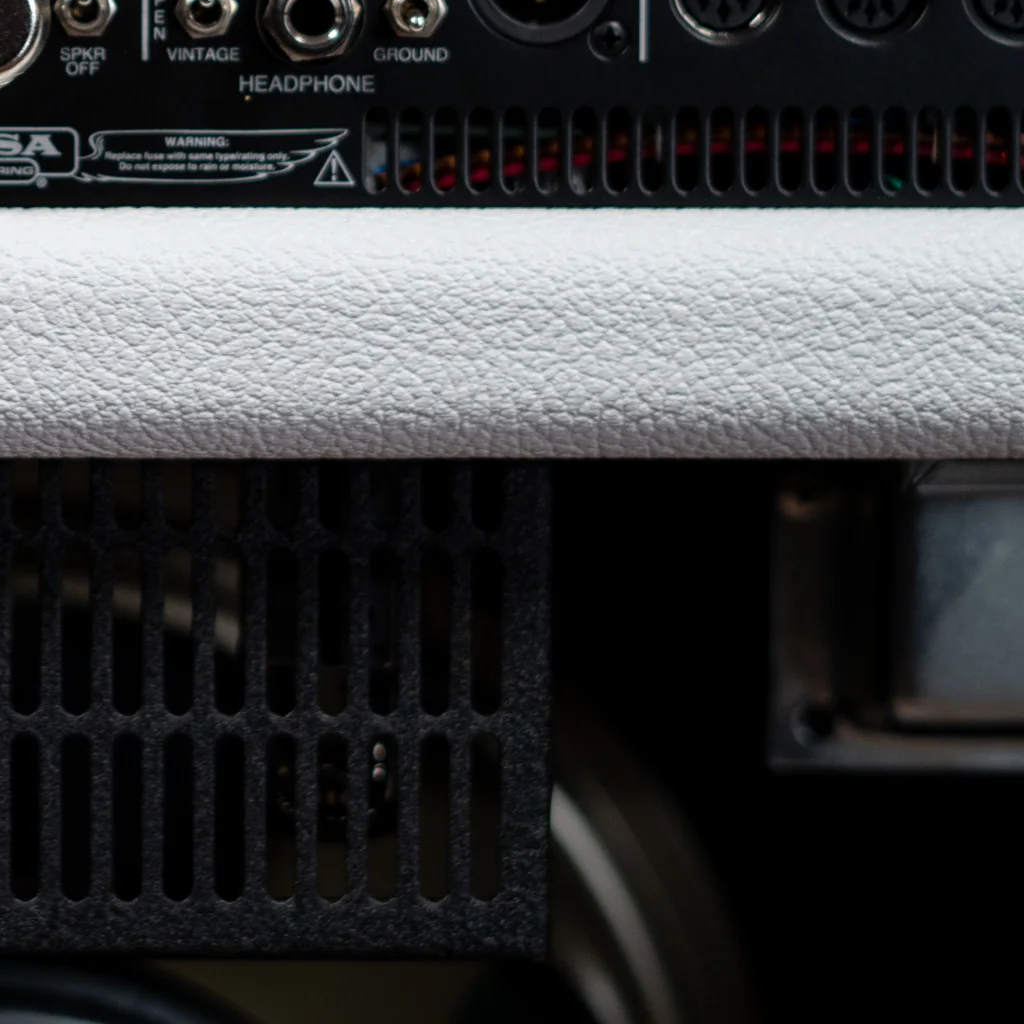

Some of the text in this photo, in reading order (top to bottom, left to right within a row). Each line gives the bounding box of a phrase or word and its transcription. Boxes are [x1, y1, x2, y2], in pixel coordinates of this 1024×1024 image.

[59, 46, 107, 63] SPKR
[166, 46, 240, 62] VINTAGE
[373, 47, 449, 63] GROUND
[64, 61, 100, 77] OFF
[238, 73, 375, 94] HEADPHONE
[164, 135, 230, 148] WARNING:
